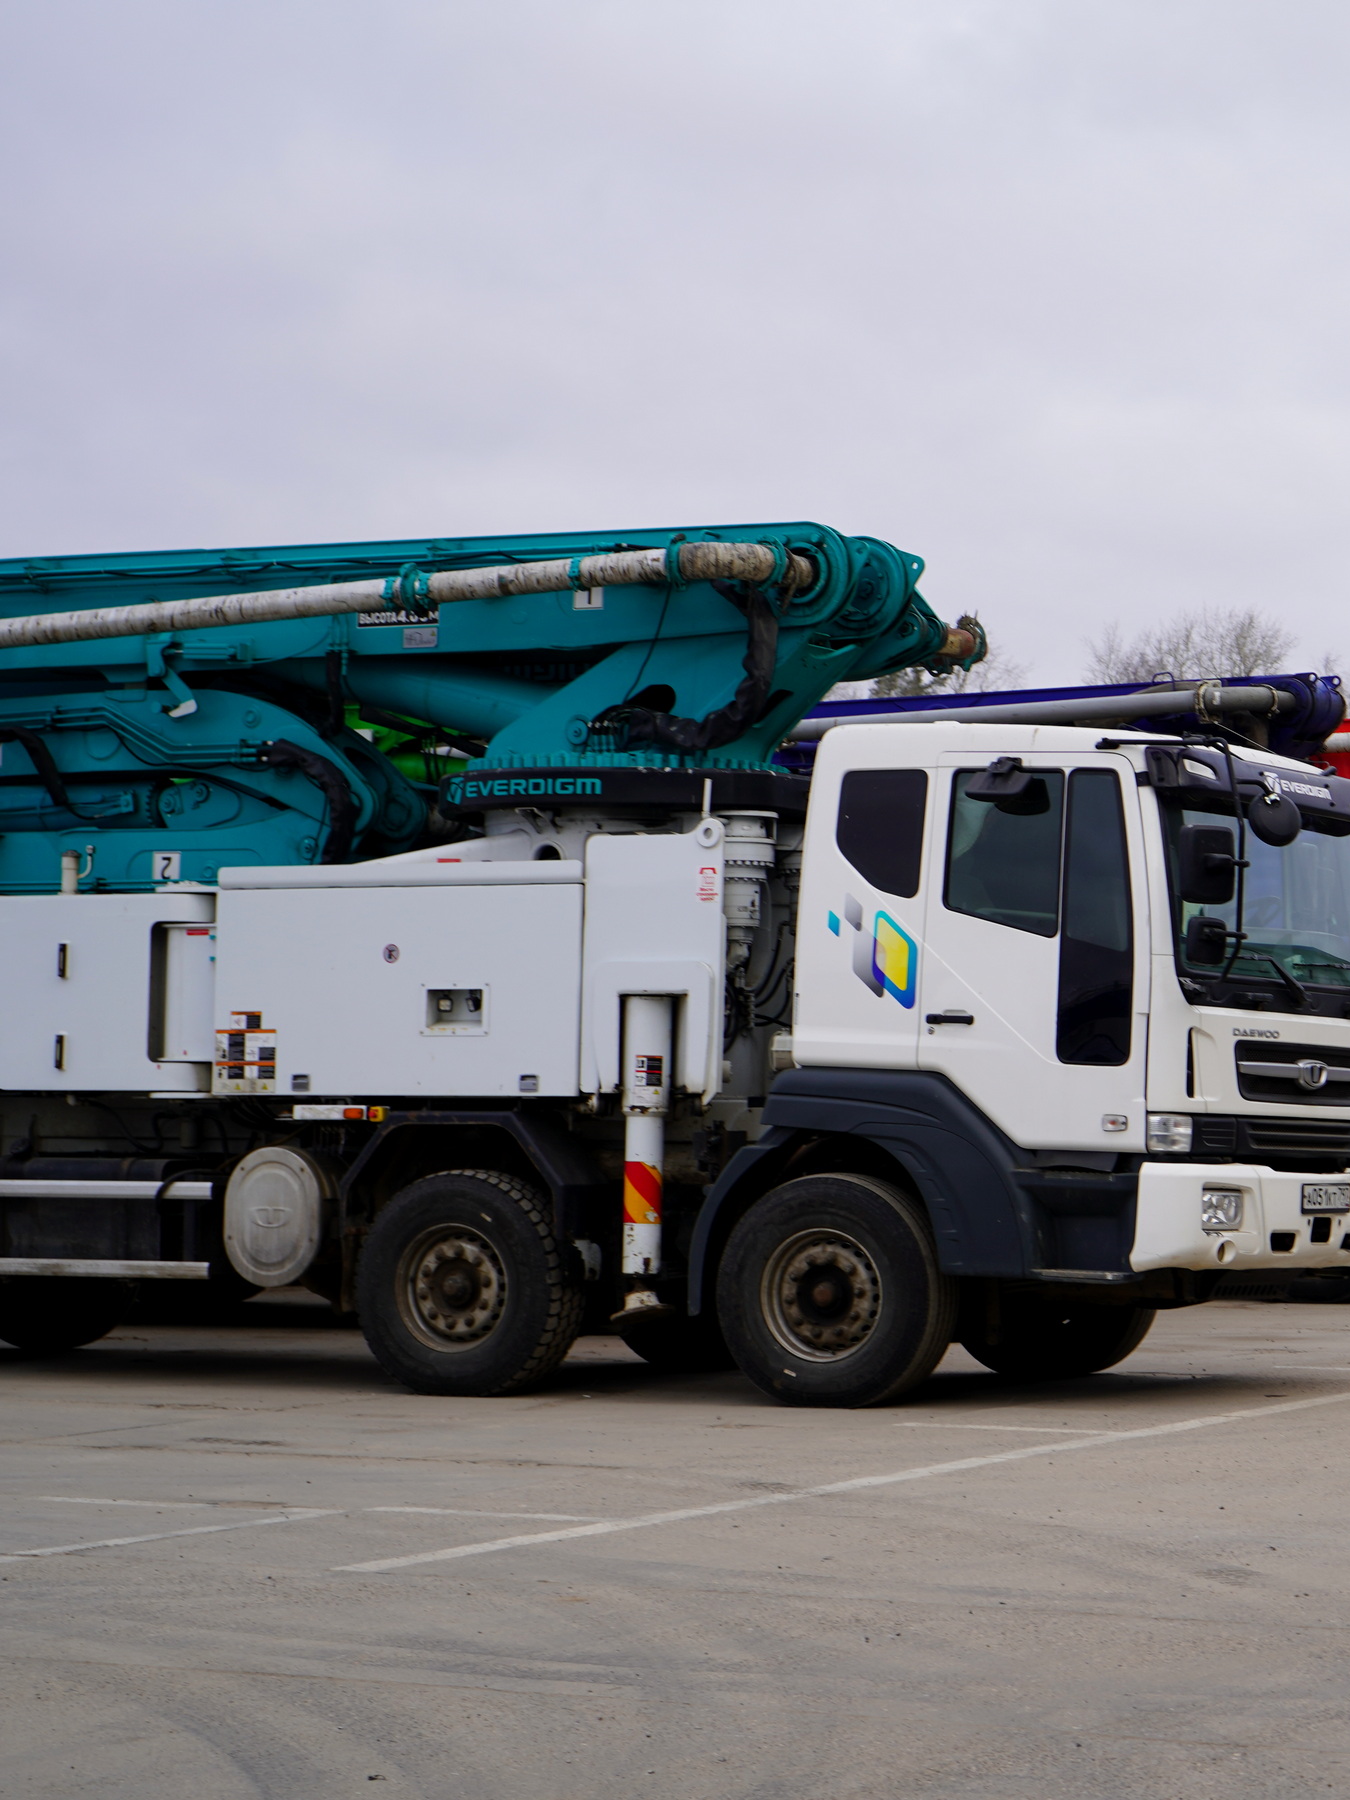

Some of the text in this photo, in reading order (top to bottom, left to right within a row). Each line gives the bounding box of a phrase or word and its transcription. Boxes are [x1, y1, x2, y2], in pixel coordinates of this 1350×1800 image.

[465, 778, 602, 797] EVERDIGM
[1280, 779, 1332, 800] EVERDIGM
[1232, 1027, 1280, 1039] DAEWOO
